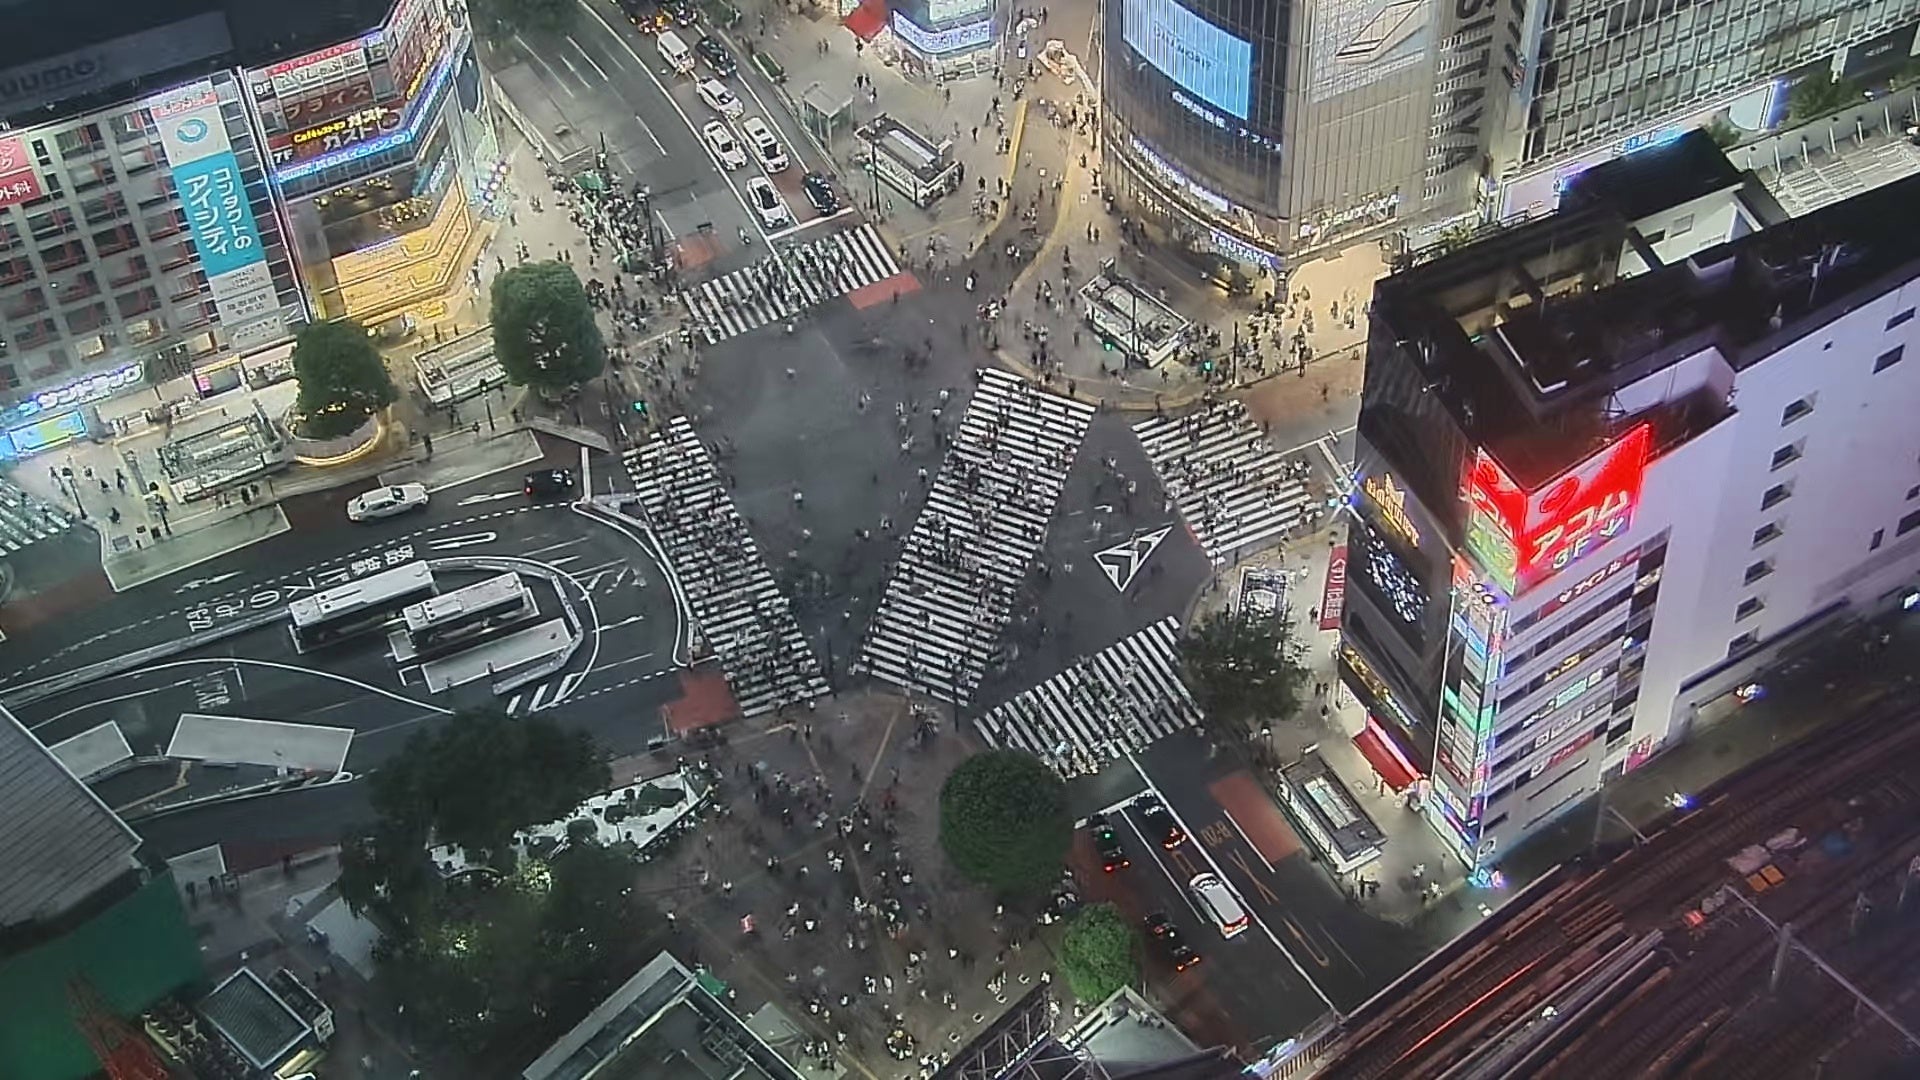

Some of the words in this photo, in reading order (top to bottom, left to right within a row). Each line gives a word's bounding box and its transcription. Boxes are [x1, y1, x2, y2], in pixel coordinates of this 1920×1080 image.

[254, 82, 272, 96] 9F
[273, 149, 294, 164] 7F
[183, 173, 228, 256] アイシティ
[212, 166, 252, 250] コンタクトの
[1322, 193, 1400, 227] TSUTAYA
[1209, 230, 1271, 267] TSUTAYA
[1529, 490, 1628, 564] アコム
[1552, 532, 1591, 569] 3F
